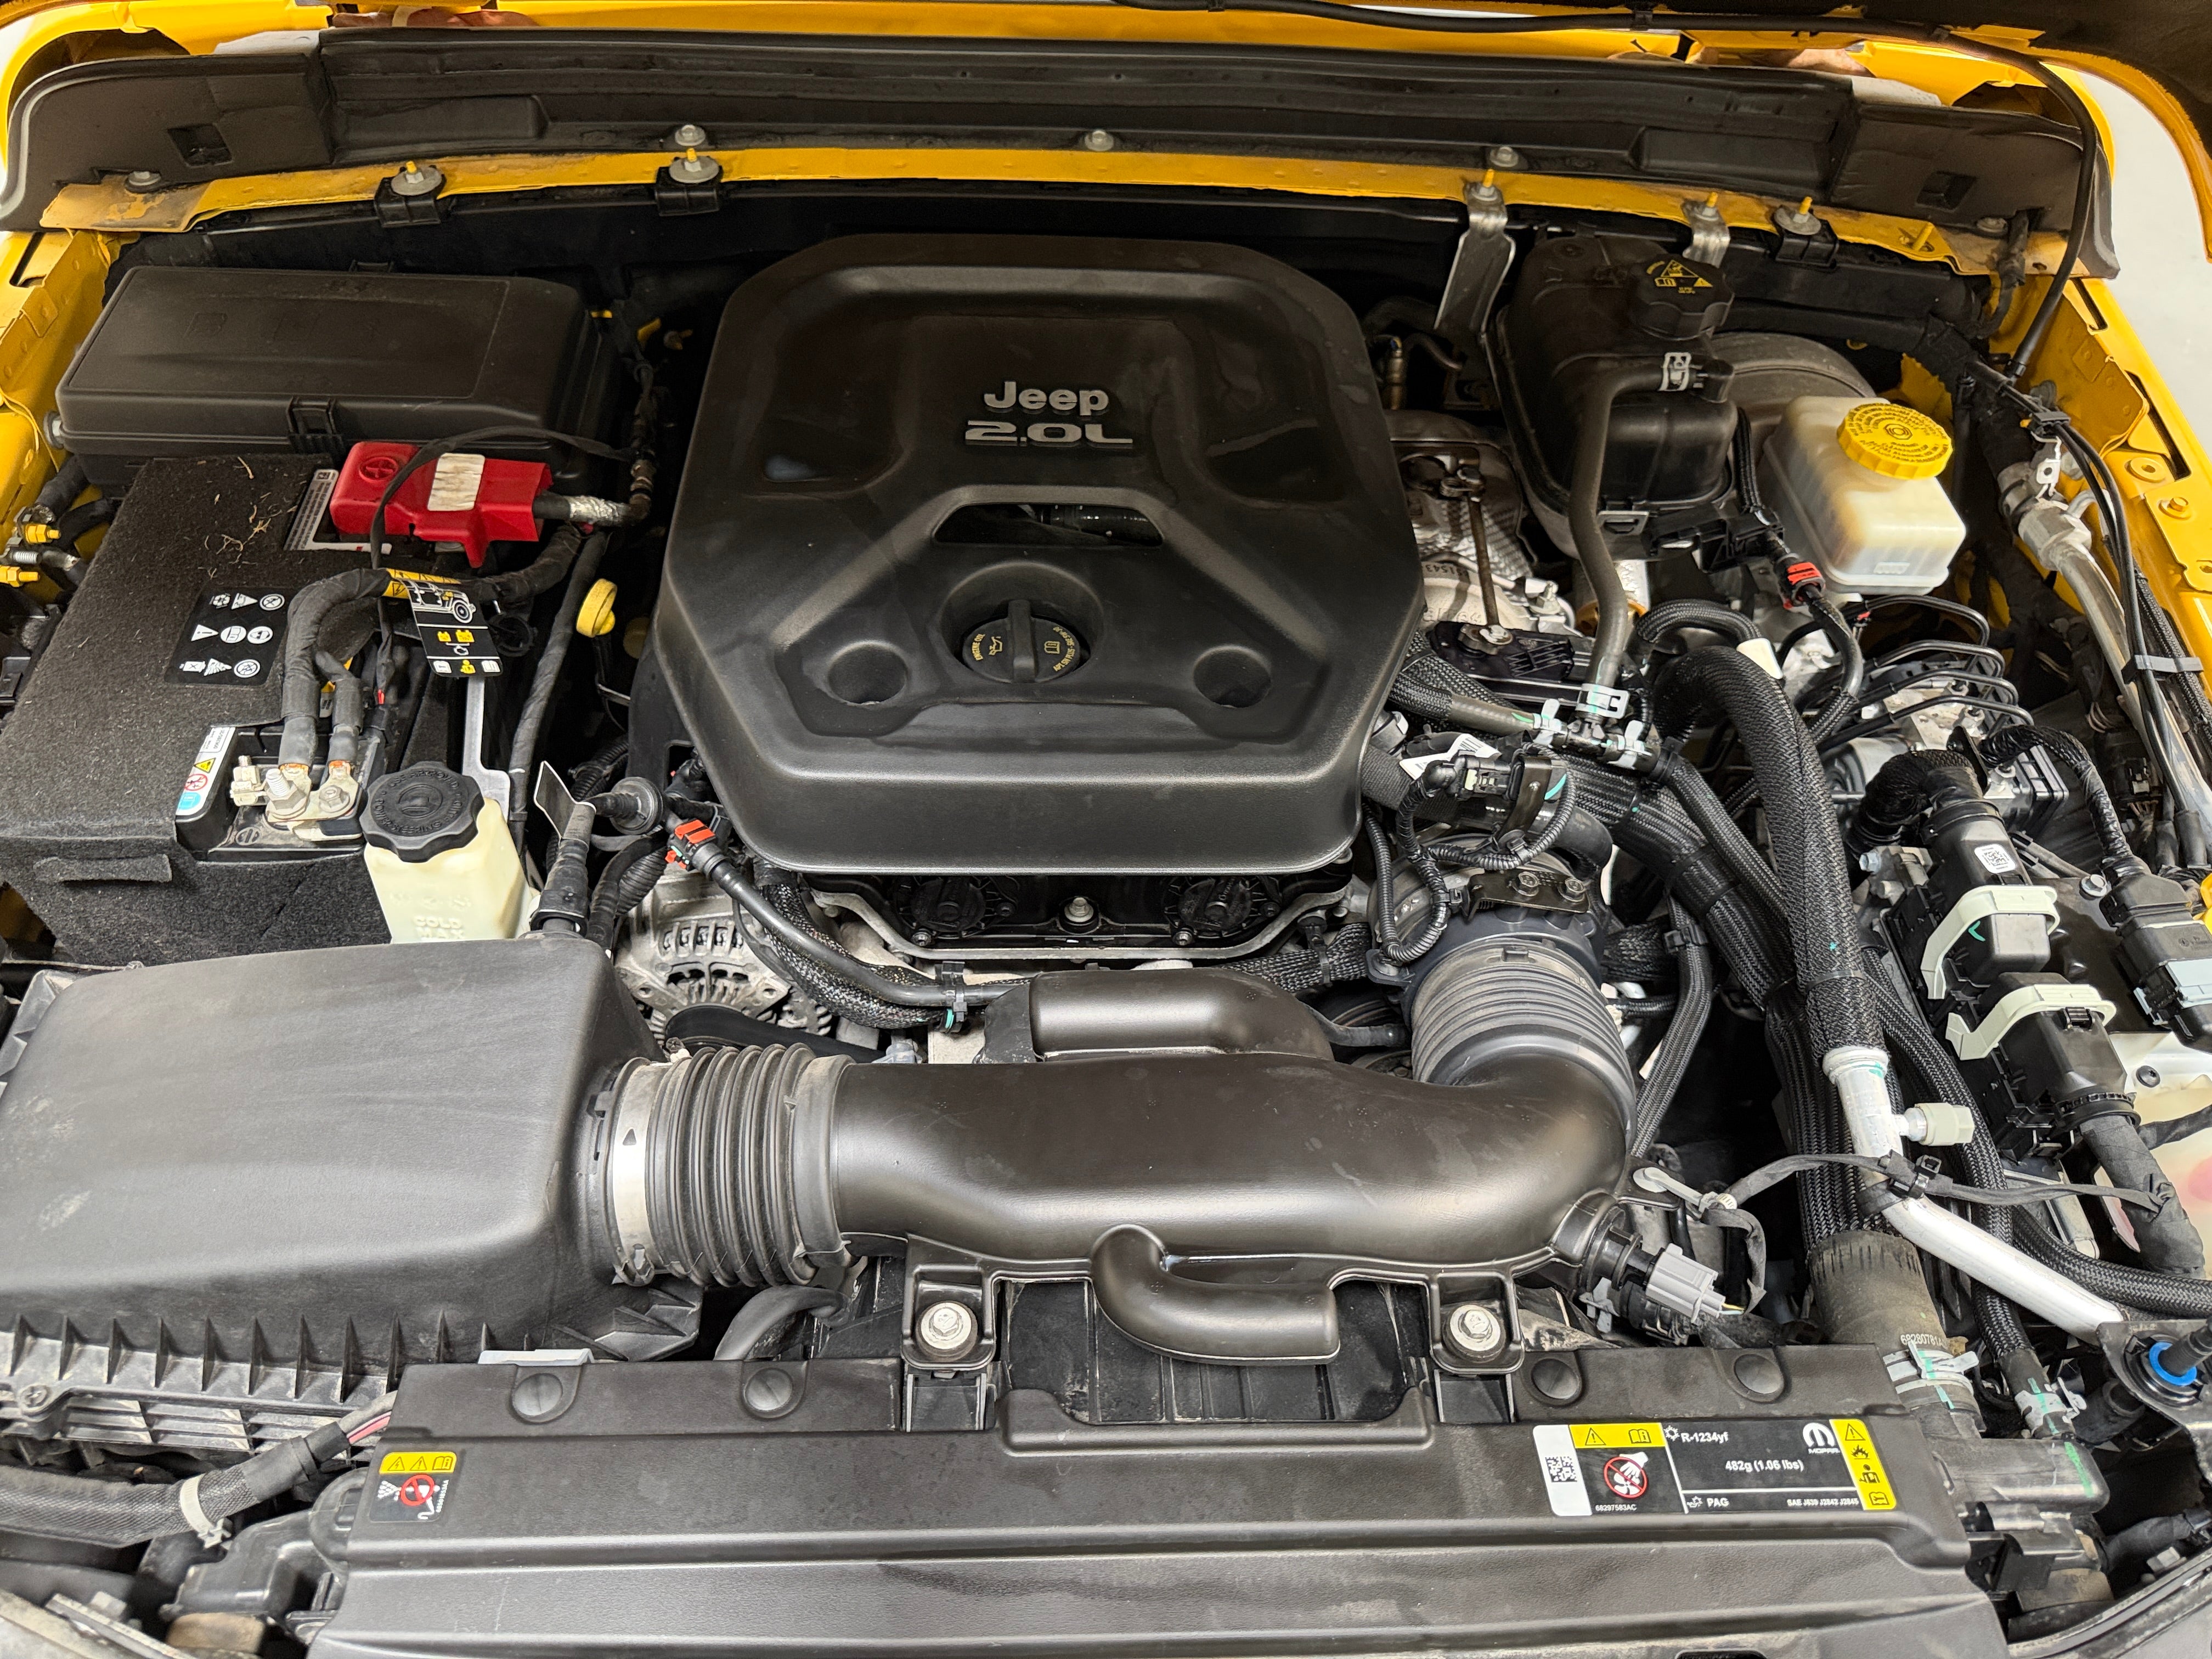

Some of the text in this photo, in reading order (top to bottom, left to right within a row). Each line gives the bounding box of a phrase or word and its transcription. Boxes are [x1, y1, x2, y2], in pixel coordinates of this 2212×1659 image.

[984, 381, 1109, 416] Jeep
[965, 420, 1133, 445] 2.0L
[972, 634, 986, 661] ENGINE OIL
[375, 798, 391, 826] POWER
[390, 820, 443, 834] STEERING
[414, 916, 462, 929] COLD
[415, 927, 465, 939] MAX
[1680, 1431, 1729, 1444] R-1234yf
[1725, 1459, 1804, 1472] 482g (1.06 lbs)
[1707, 1497, 1730, 1508] PAG
